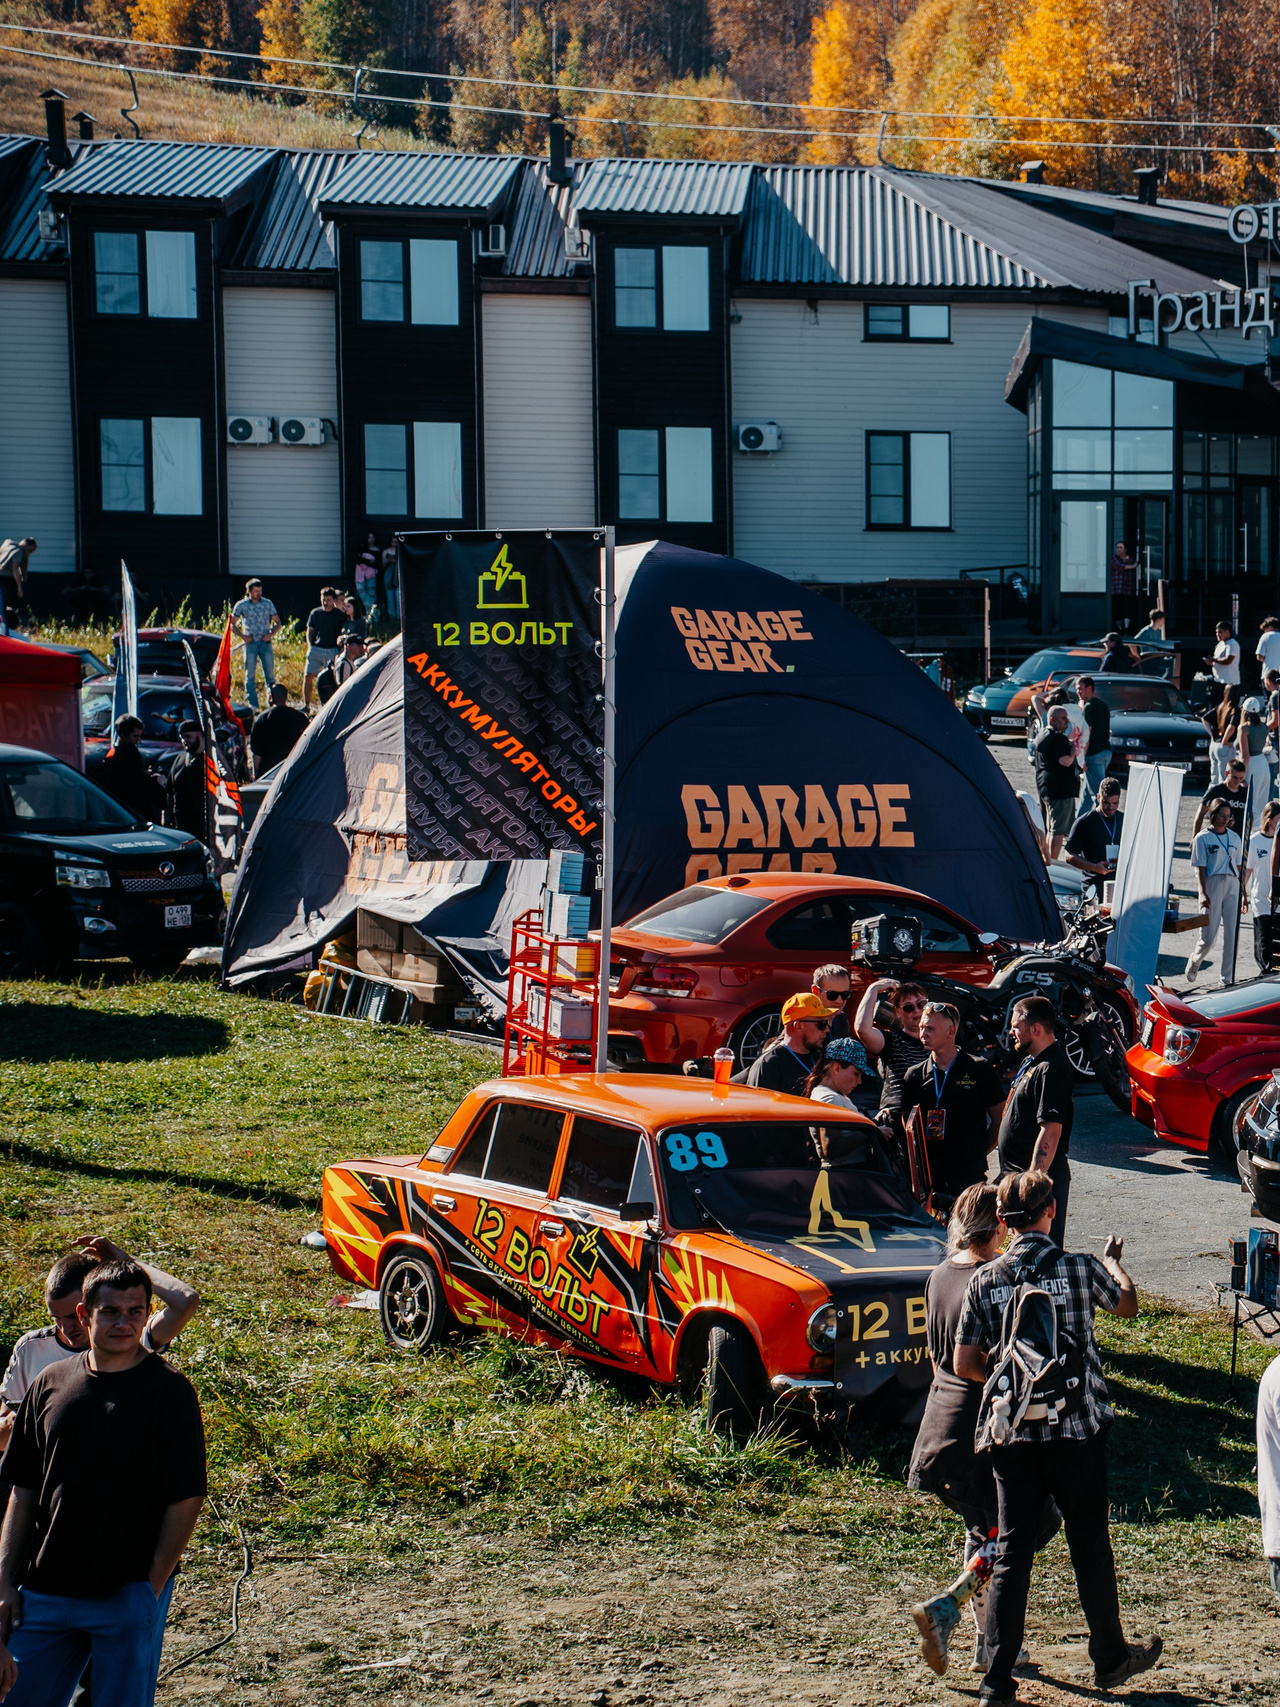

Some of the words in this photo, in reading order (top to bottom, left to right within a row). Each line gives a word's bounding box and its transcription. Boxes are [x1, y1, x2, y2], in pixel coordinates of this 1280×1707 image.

[1128, 278, 1278, 347] Гранд
[433, 622, 460, 646] 12
[469, 621, 574, 646] ВОЛЬТ
[671, 606, 814, 641] GARAGE
[407, 651, 598, 837] АККУМУЛЯТОРЫ
[681, 784, 915, 848] GARAGE
[1015, 970, 1056, 986] GS
[665, 1131, 729, 1172] 89
[472, 1197, 507, 1256] 12
[504, 1225, 613, 1338] ВОЛЬТ
[488, 1259, 559, 1322] аккумуляторных
[990, 1285, 1013, 1304] DENI
[847, 1301, 890, 1342] 12
